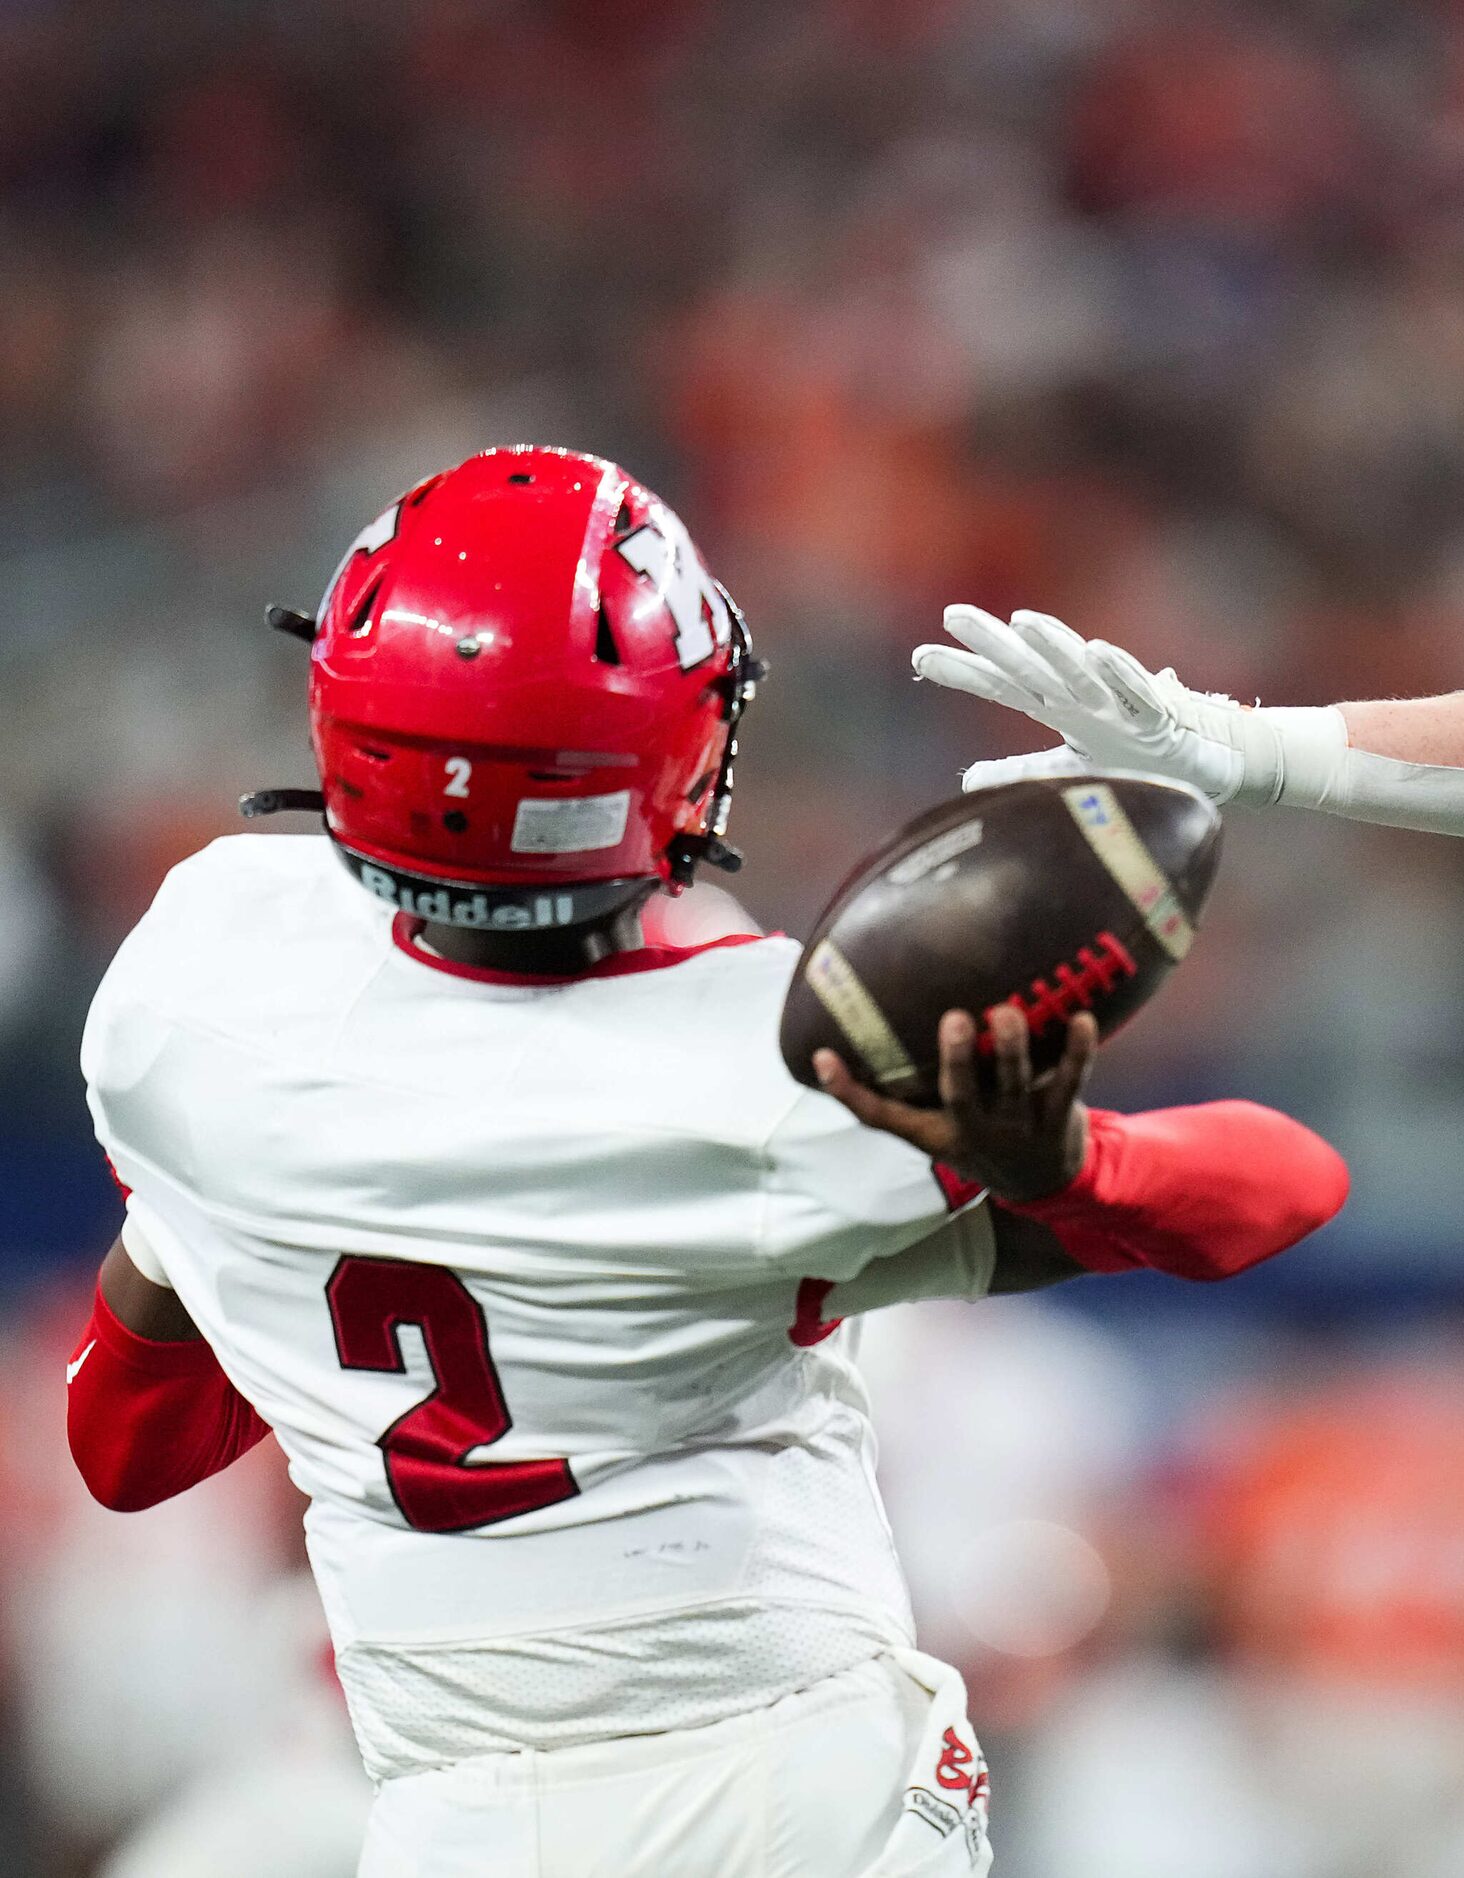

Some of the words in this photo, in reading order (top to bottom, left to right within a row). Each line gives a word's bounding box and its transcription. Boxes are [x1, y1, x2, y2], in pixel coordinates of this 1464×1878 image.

[444, 756, 471, 798] 2
[361, 863, 573, 928] Riddell
[325, 1253, 581, 1533] 2
